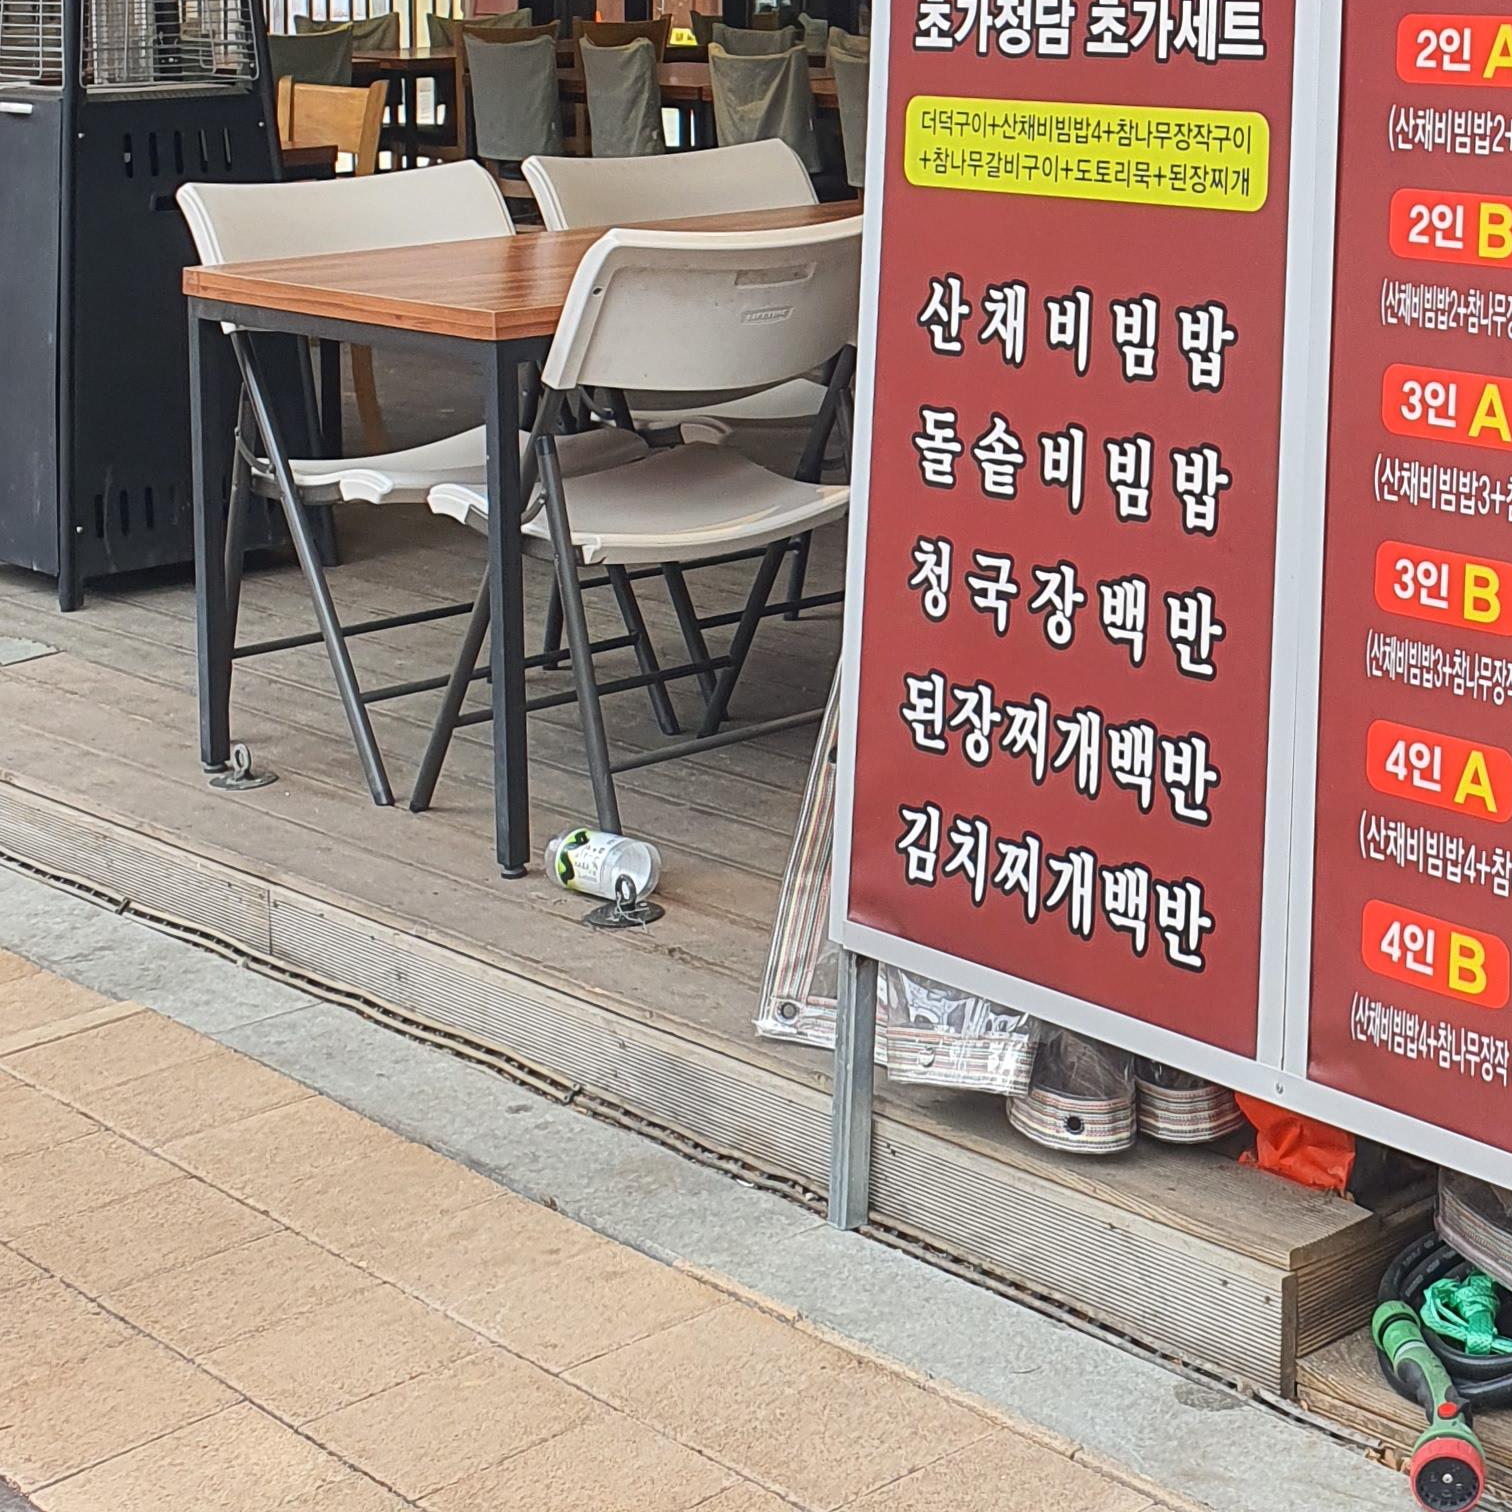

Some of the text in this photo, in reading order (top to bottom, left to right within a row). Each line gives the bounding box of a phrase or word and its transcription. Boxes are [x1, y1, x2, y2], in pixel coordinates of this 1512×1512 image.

[1415, 28, 1471, 73] 2인
[1408, 204, 1464, 249] 2인
[1401, 380, 1457, 428] 3인
[1468, 383, 1512, 442] A
[1393, 558, 1449, 609] 3인
[1464, 563, 1501, 623] B
[901, 670, 1217, 824] 된장찌개백반
[1385, 740, 1442, 792] 4인
[1454, 751, 1497, 813] A
[898, 802, 1214, 968] 김치찌개백반
[1381, 921, 1436, 976] 4인
[1448, 930, 1487, 995] B
